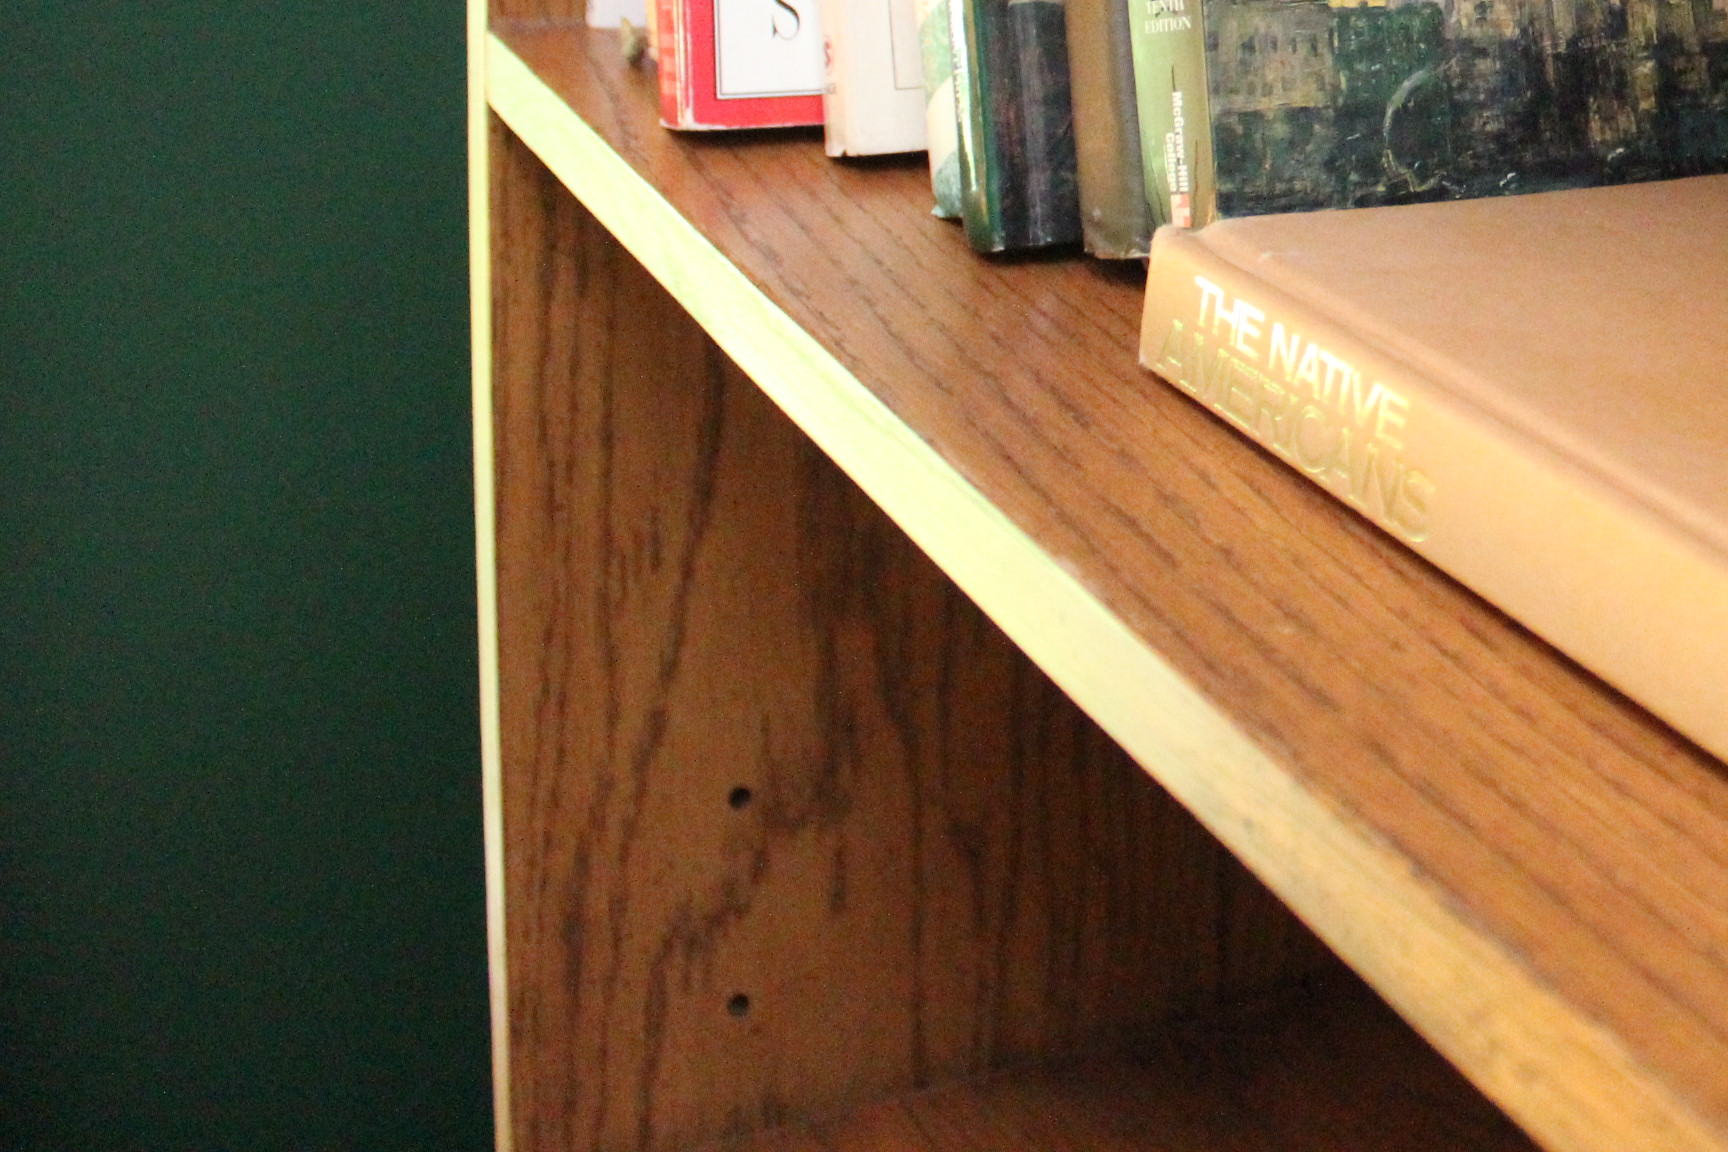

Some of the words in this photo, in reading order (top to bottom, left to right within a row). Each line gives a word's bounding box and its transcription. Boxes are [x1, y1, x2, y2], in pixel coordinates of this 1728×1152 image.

[1144, 16, 1192, 34] EDITION
[1171, 90, 1189, 192] McGraw-Hill
[1194, 274, 1266, 360] THE
[1267, 321, 1411, 451] NATIVE
